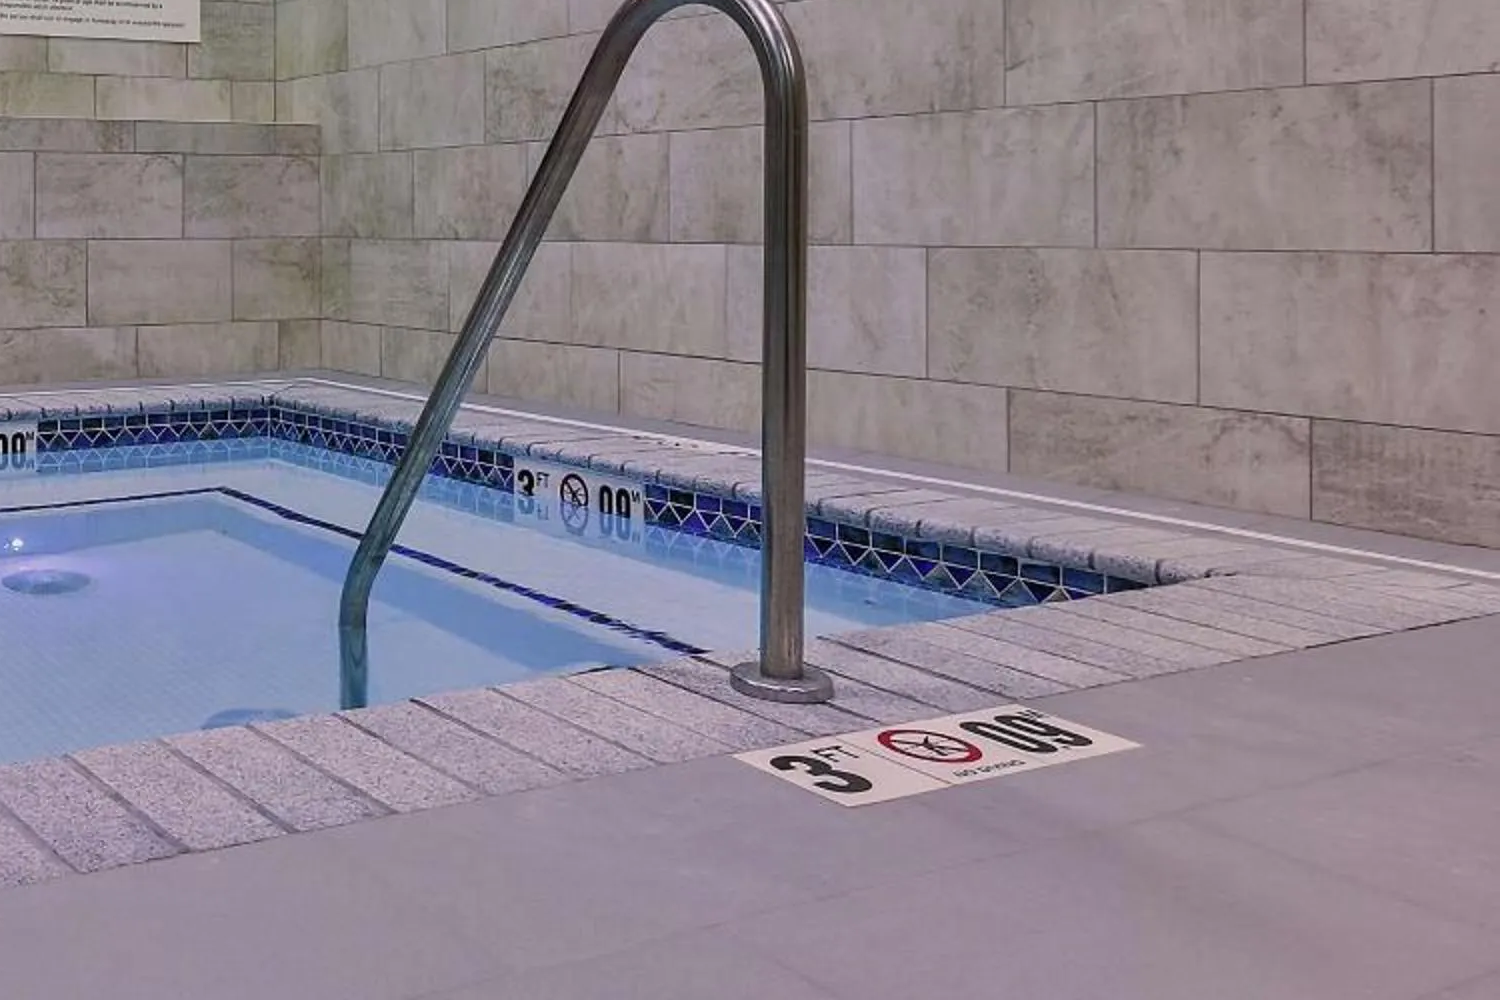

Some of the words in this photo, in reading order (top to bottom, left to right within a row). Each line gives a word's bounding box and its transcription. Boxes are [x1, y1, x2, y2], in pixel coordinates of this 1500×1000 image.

[536, 472, 549, 488] FT
[810, 745, 860, 763] FT
[770, 756, 872, 793] 3
